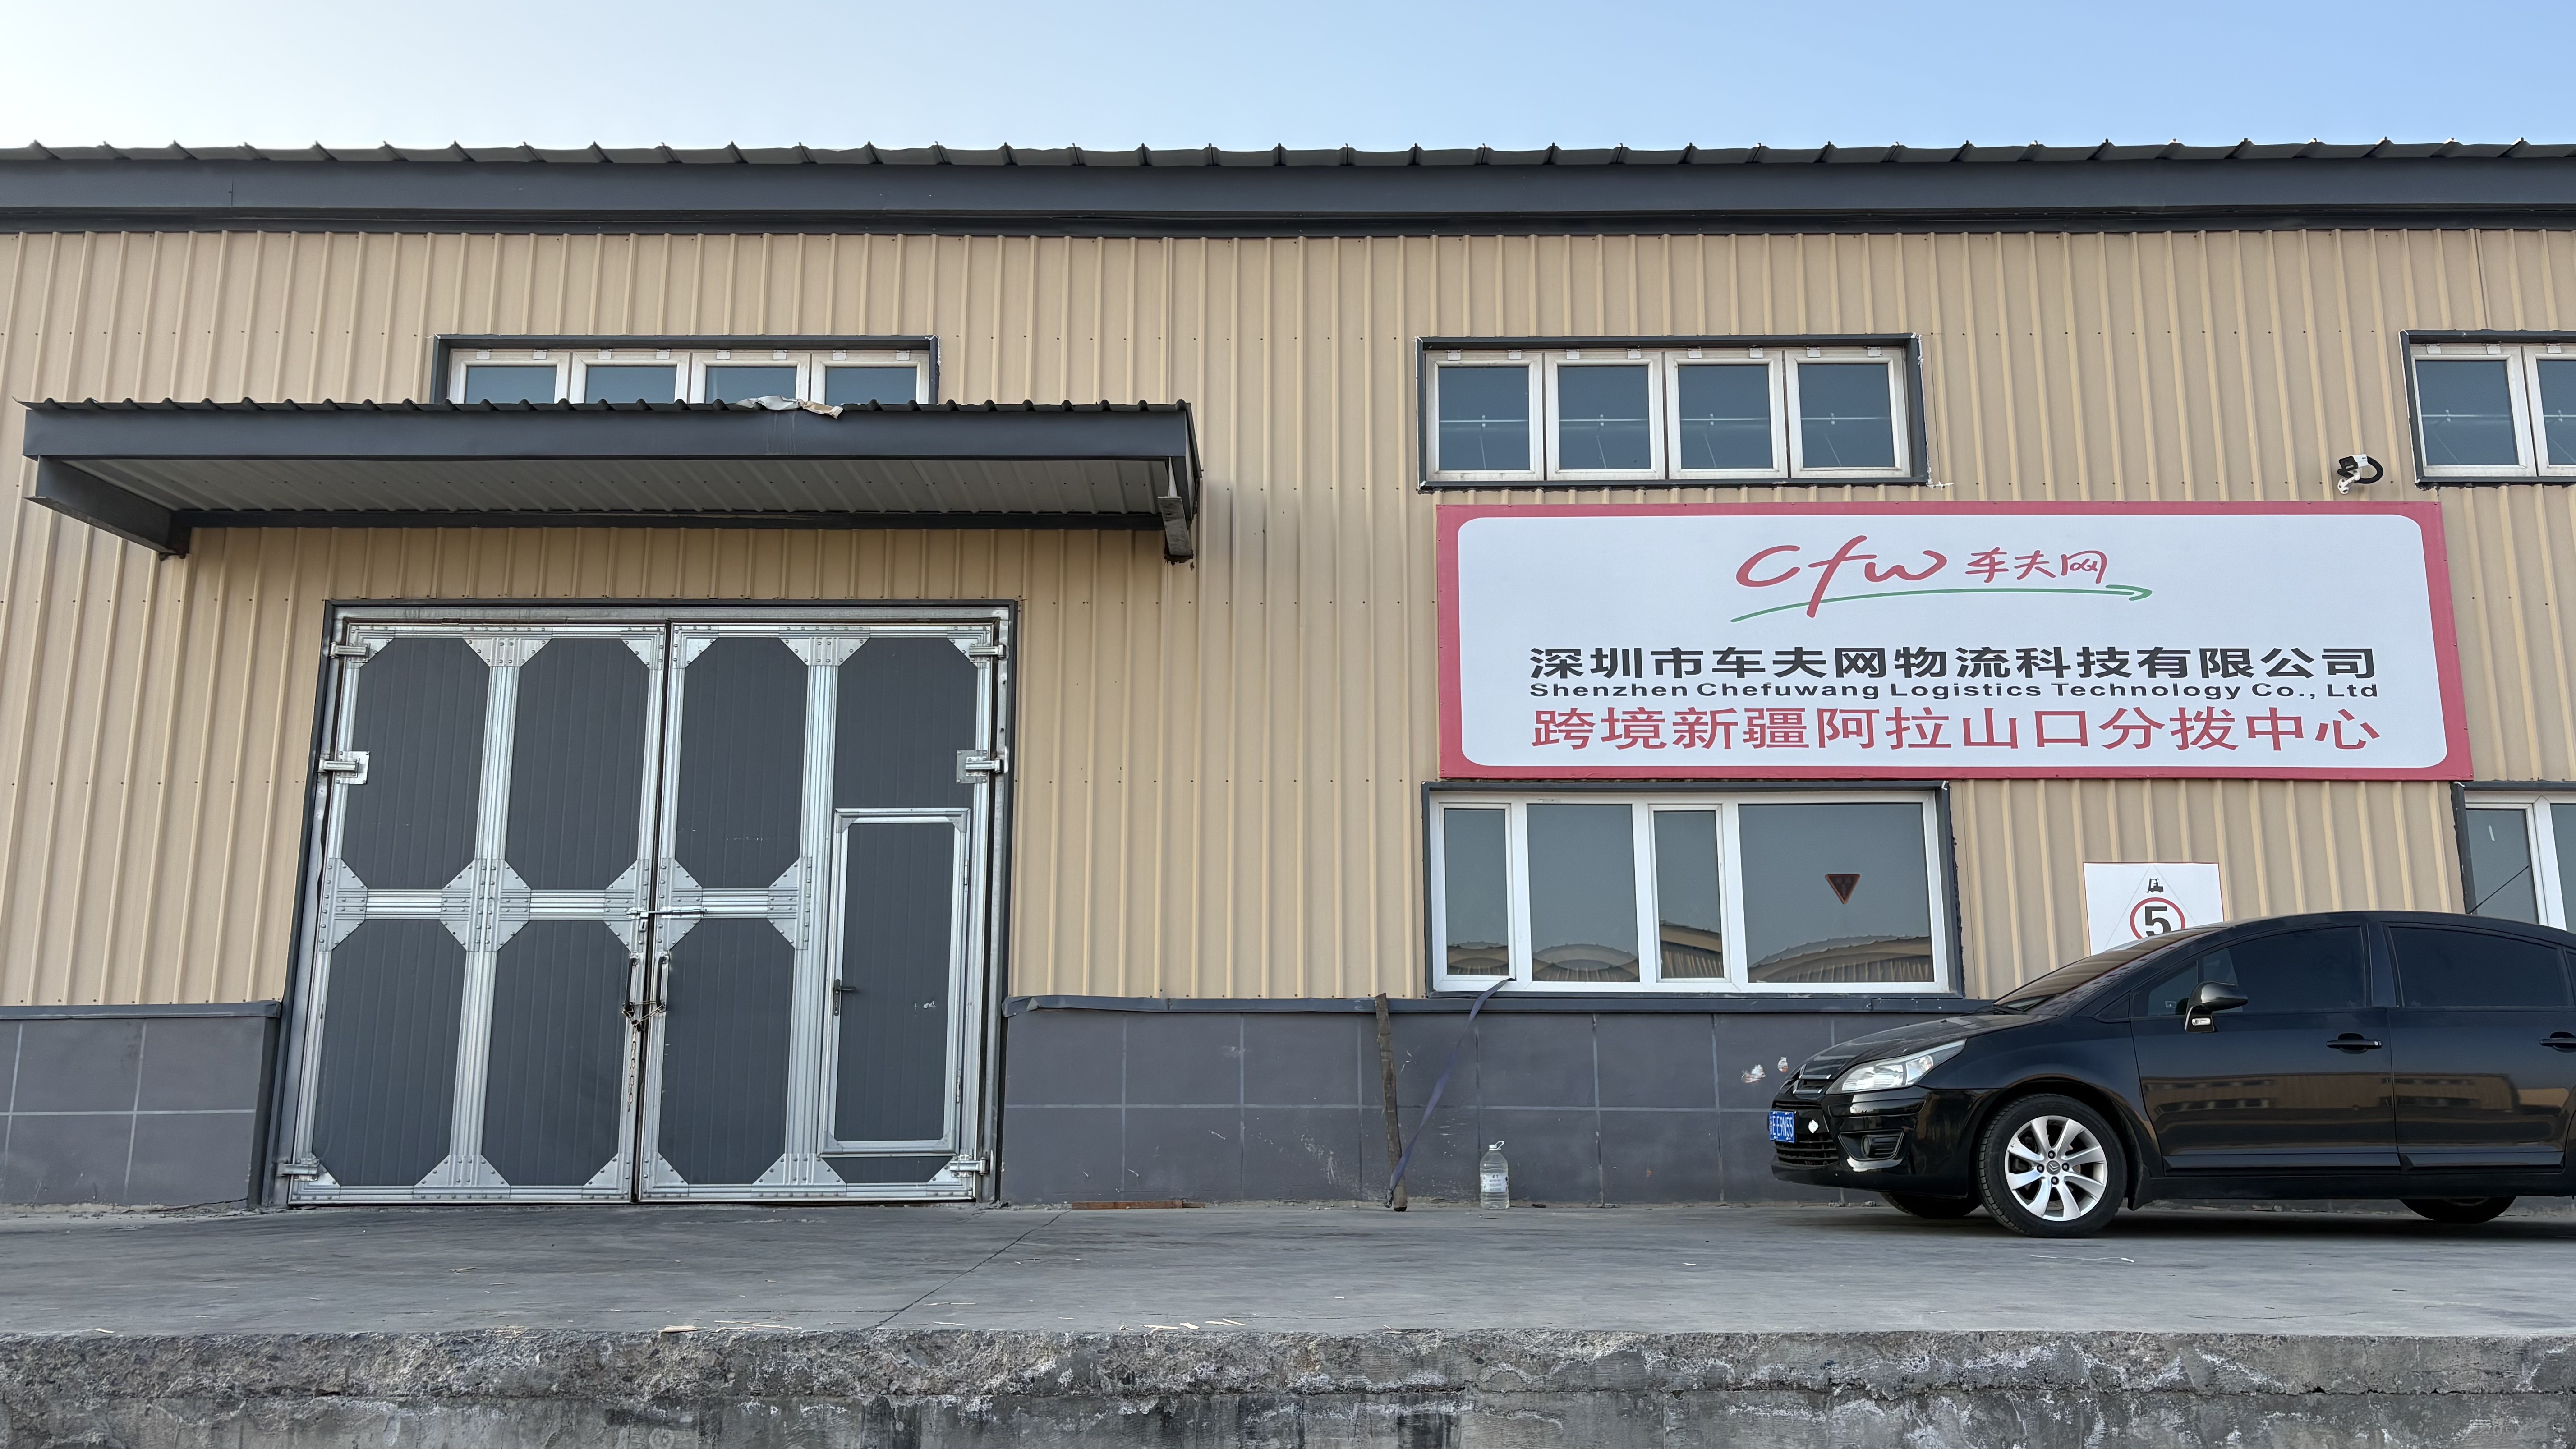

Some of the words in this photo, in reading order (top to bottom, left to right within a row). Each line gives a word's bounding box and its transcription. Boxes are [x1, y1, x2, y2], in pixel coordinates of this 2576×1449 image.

[1965, 547, 2107, 584] 车夫网
[1530, 646, 2376, 679] 深圳市车夫网物流科技有限公司
[1530, 683, 1687, 696] Shenzhen
[1697, 683, 1878, 699] Chefuwang
[1891, 683, 2041, 699] Logistics
[2051, 683, 2240, 699] Technology
[2252, 683, 2314, 699] Co.,
[2328, 684, 2377, 697] Ltd
[1532, 706, 2380, 751] 跨境新疆阿拉山口分拨中心
[2144, 906, 2171, 936] 5
